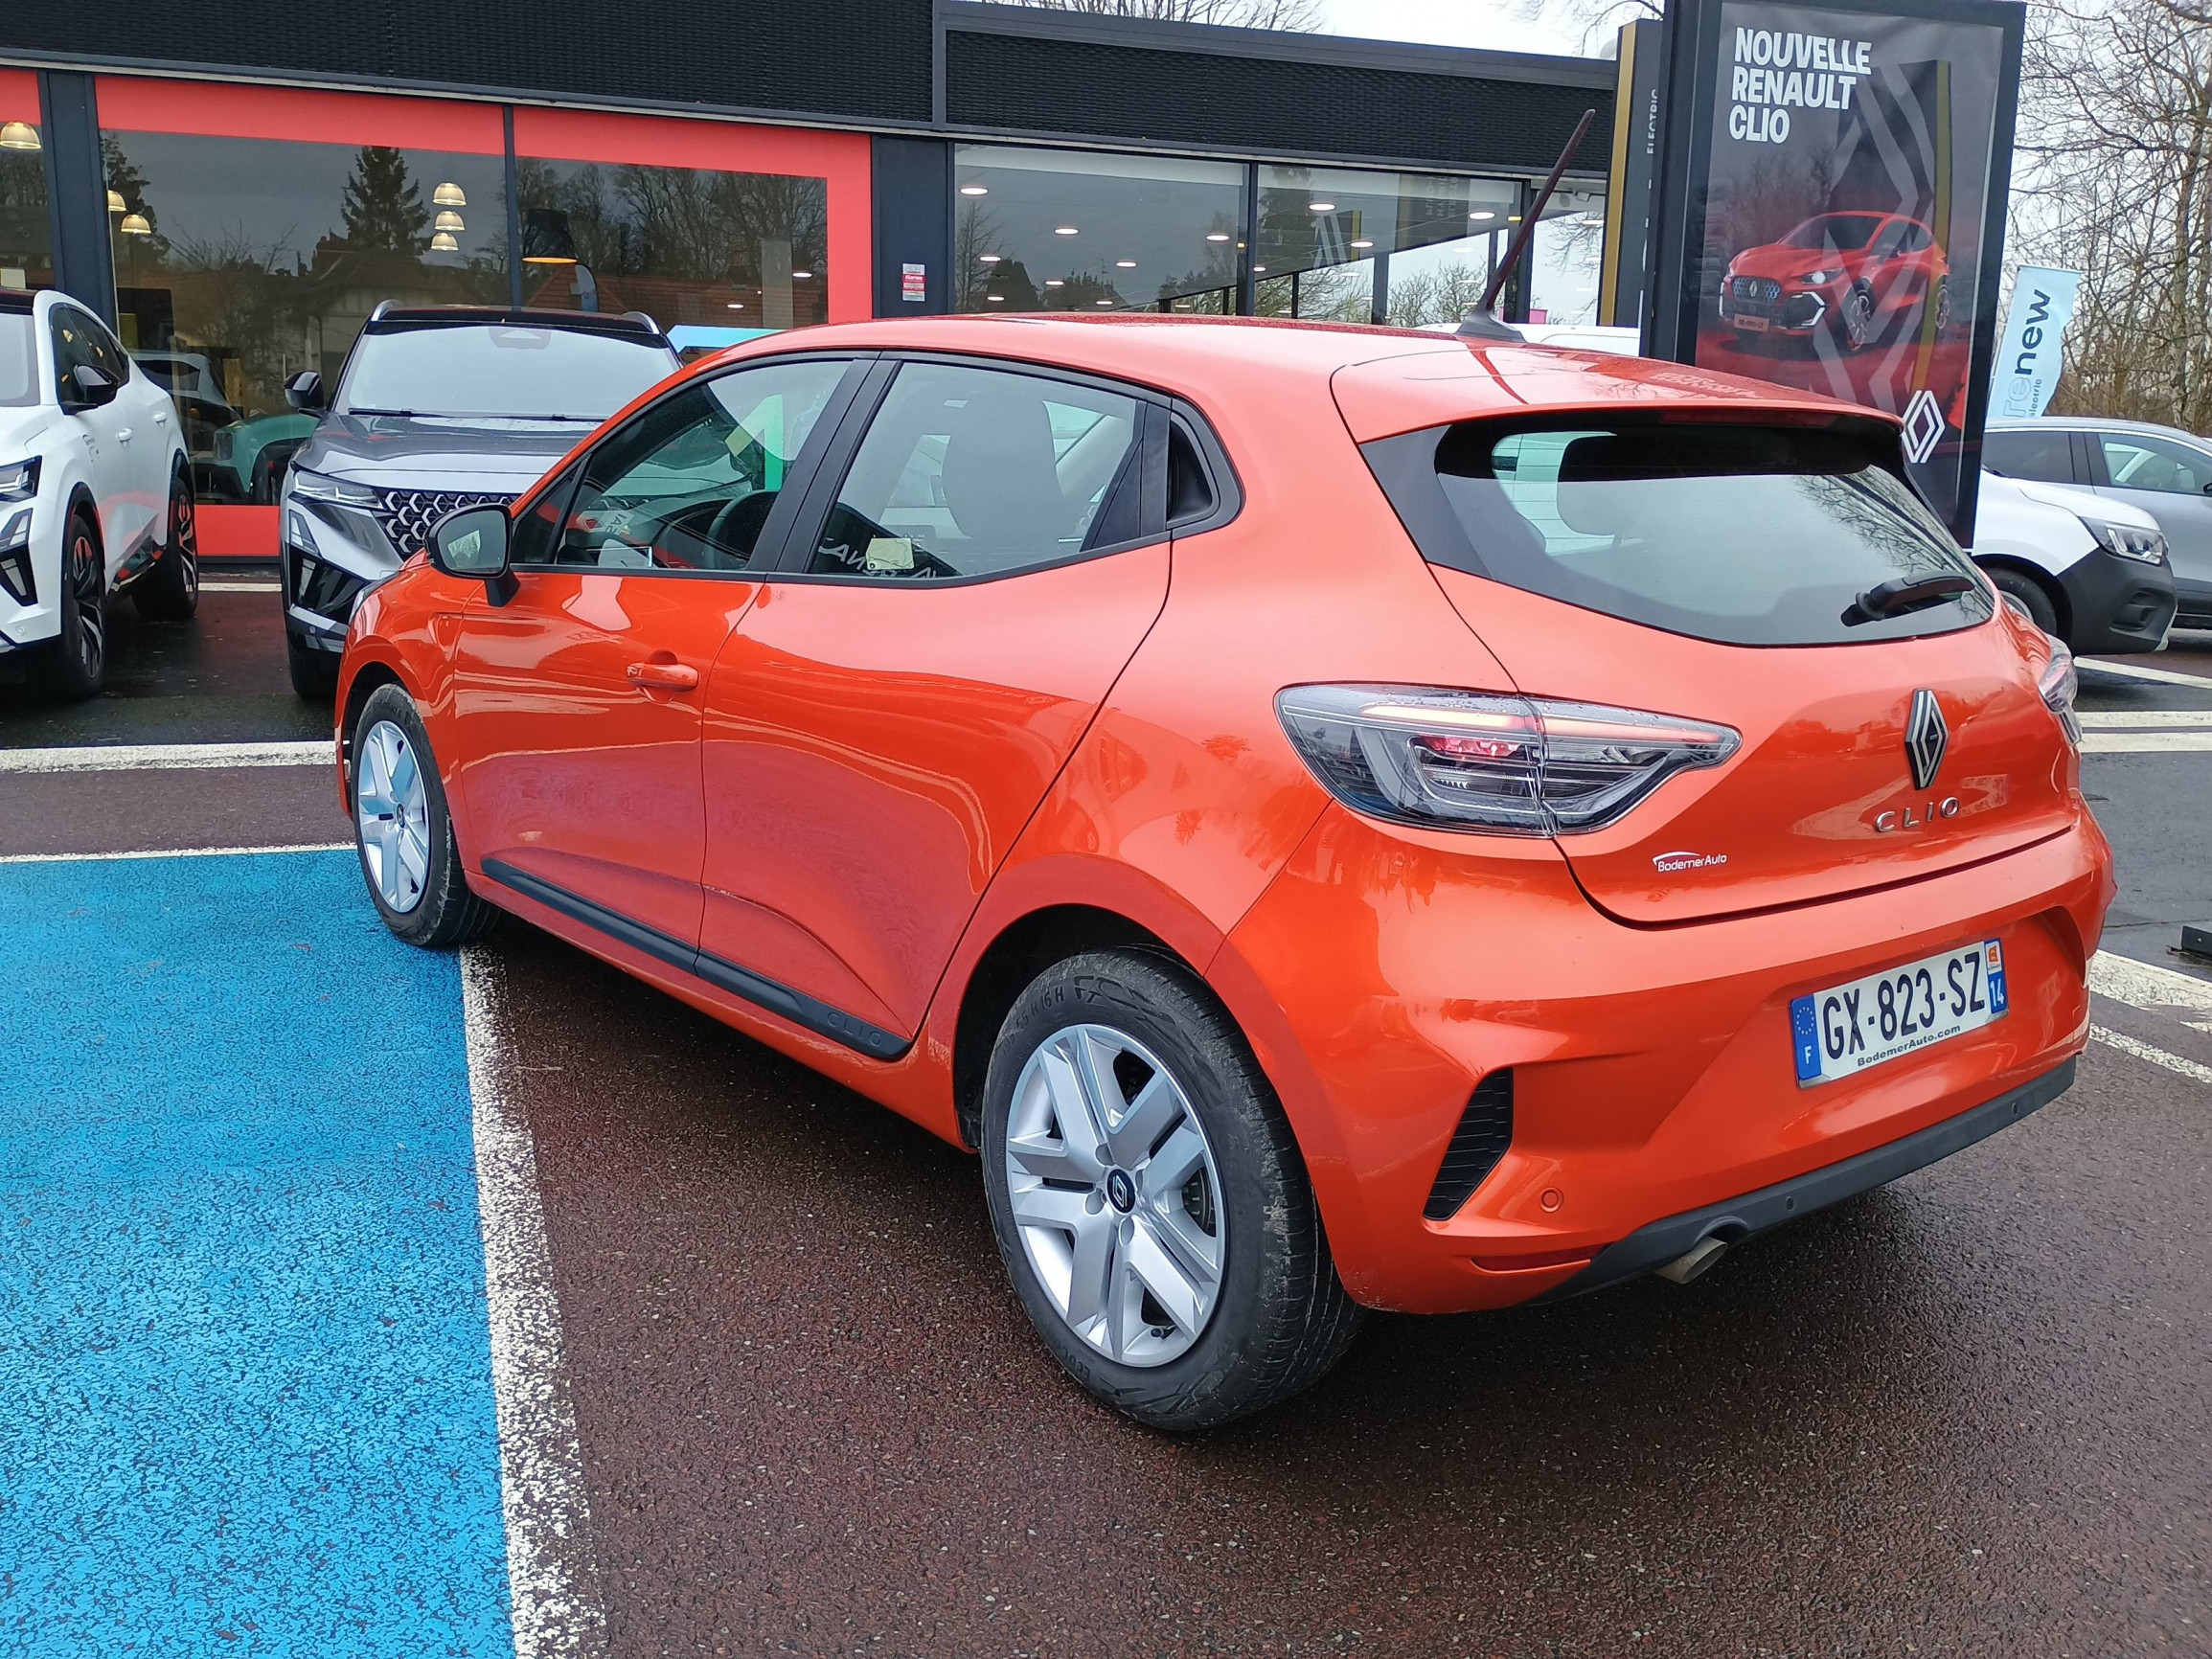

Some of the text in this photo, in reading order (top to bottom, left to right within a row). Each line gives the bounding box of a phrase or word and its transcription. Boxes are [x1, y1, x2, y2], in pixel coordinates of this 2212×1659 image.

[1734, 27, 1872, 75] NOUVELLE
[1731, 65, 1857, 110] RENAULT
[1729, 104, 1790, 144] CLIO
[2003, 289, 2051, 418] renew
[1876, 796, 1959, 832] CLIO
[1657, 853, 1727, 873] BodemerAuto
[1823, 951, 1985, 1060] GX-823-SZ
[1990, 978, 2004, 1007] 14
[827, 1011, 881, 1047] CLIO
[1857, 1025, 1961, 1067] BodemerAuto.com
[1803, 1045, 1813, 1064] F
